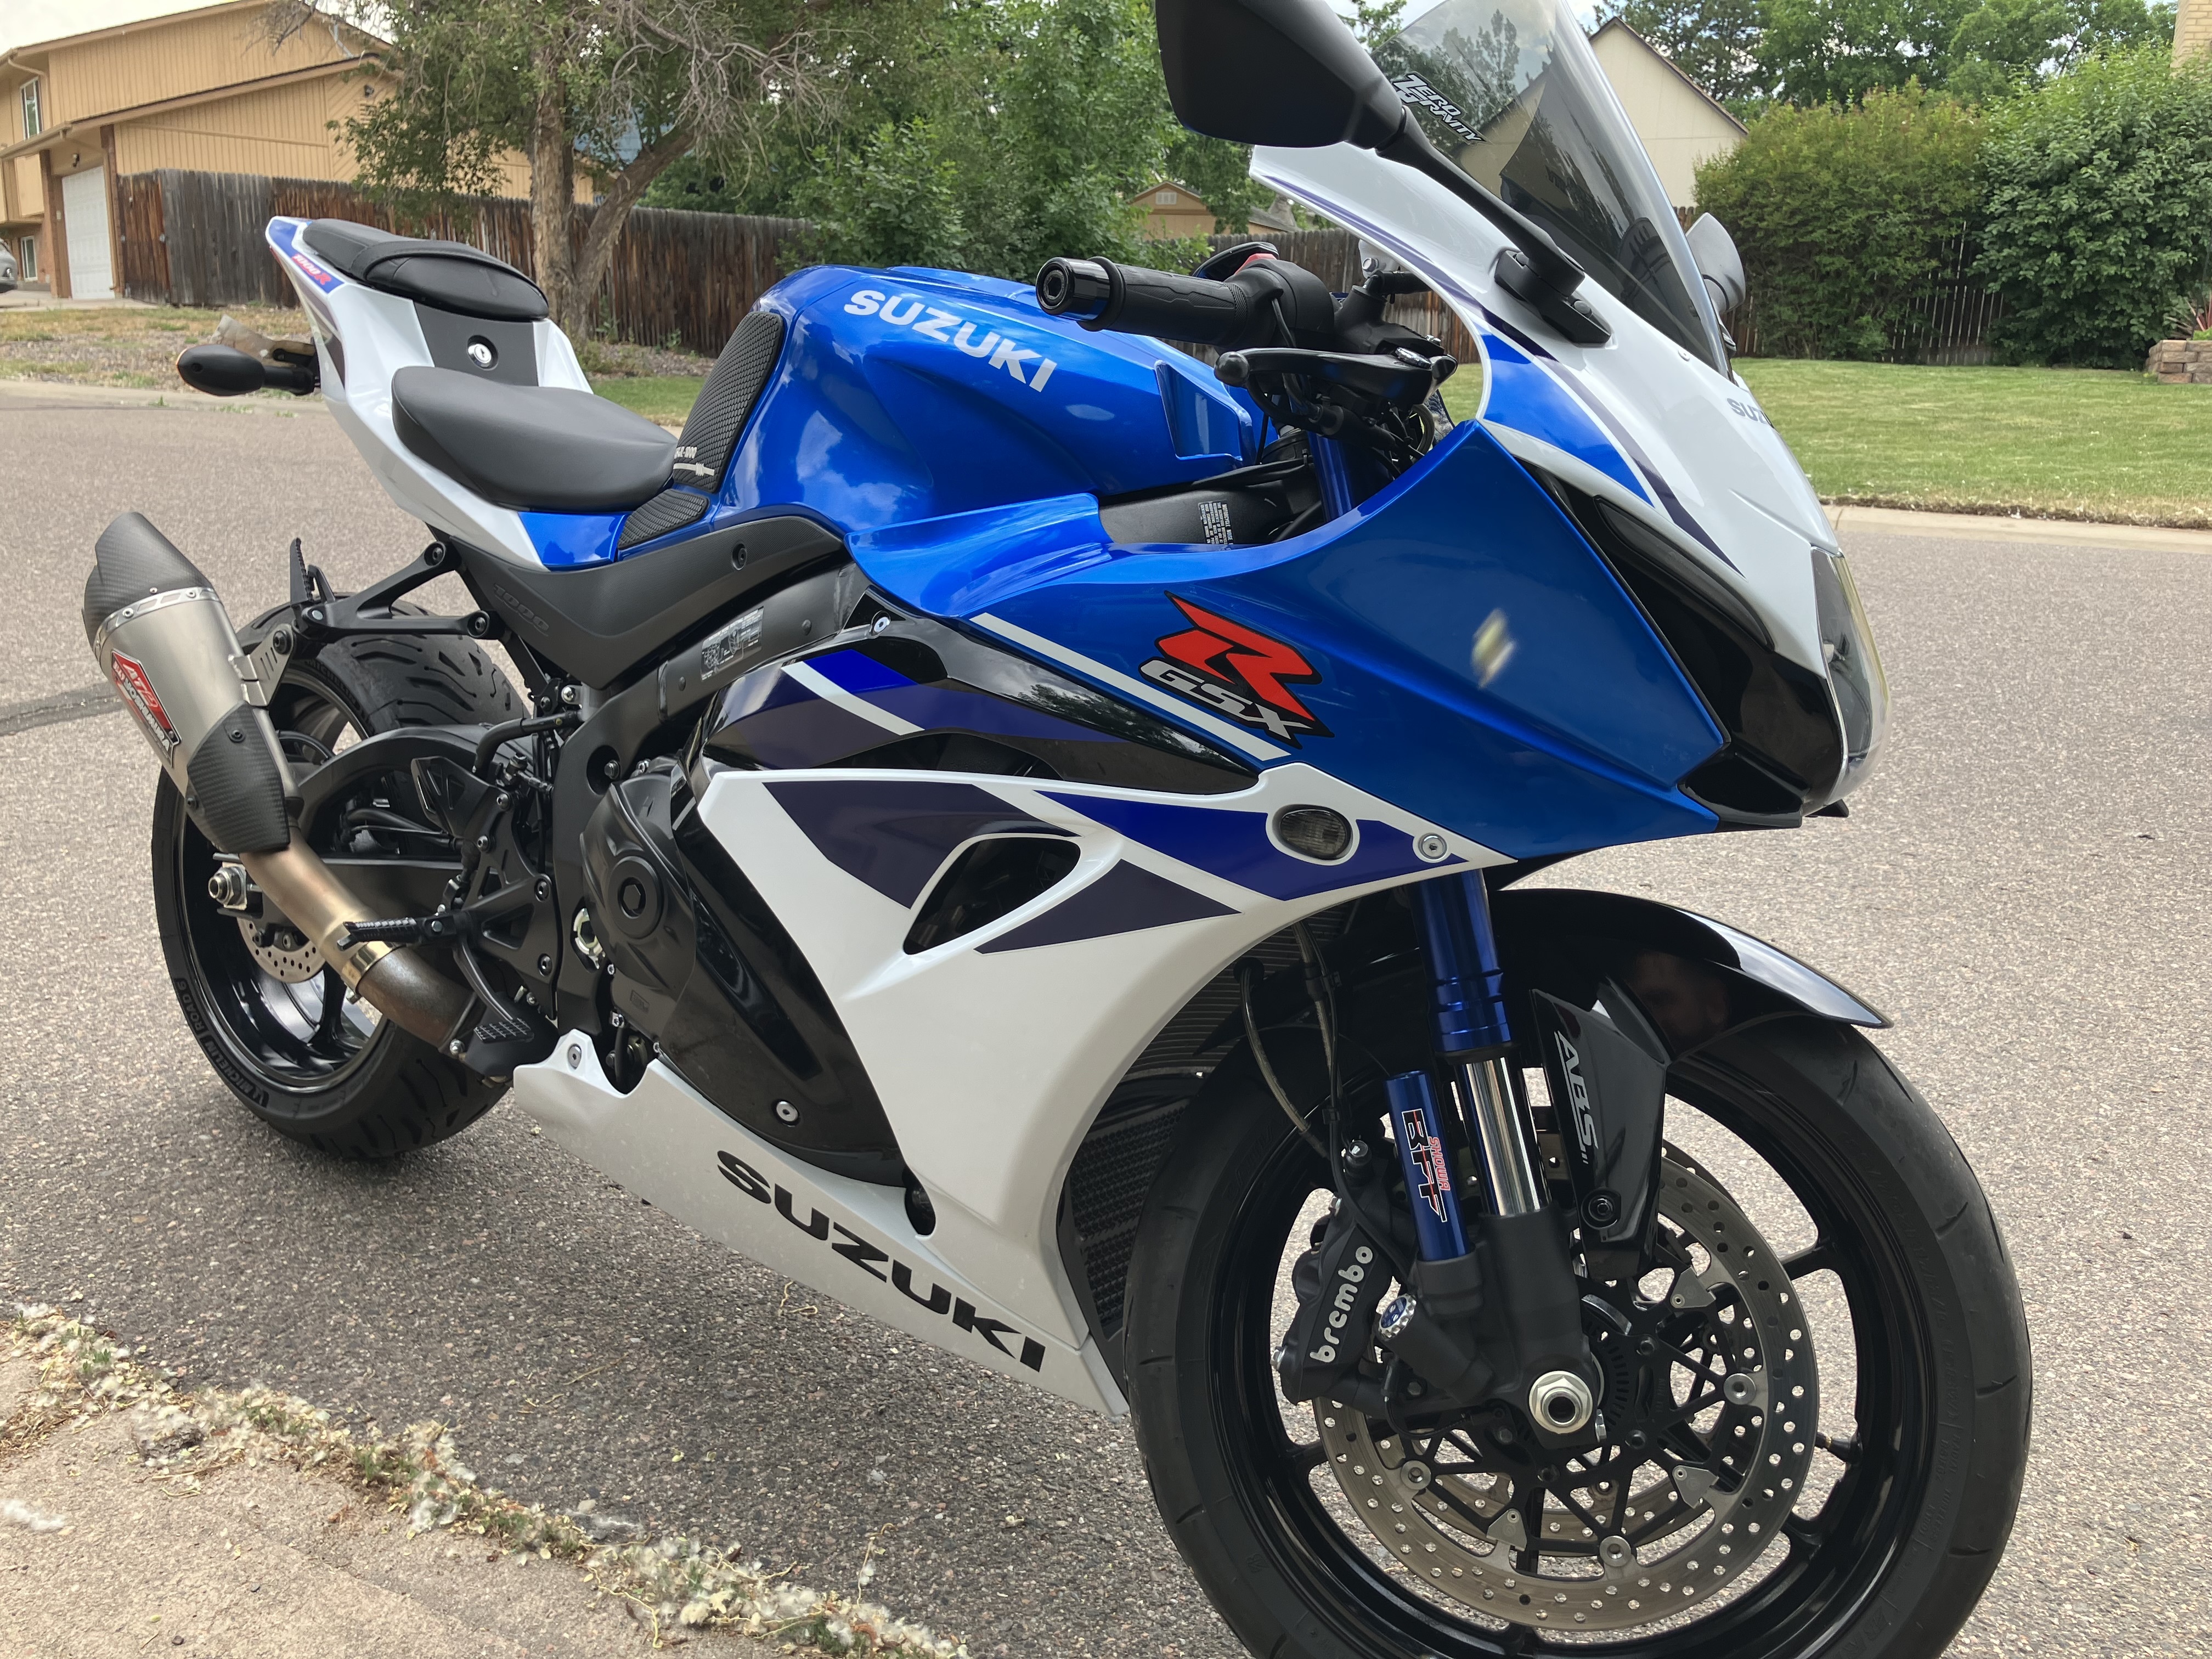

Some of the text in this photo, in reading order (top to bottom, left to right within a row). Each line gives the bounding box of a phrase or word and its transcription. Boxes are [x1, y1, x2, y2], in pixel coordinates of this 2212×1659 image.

[1393, 74, 1462, 116] ZERO
[1397, 89, 1482, 142] GRAVITY
[844, 290, 1057, 392] SUZUKI
[494, 583, 549, 636] 1000
[1158, 597, 1315, 721] R
[123, 677, 170, 752] YOSHIMURA
[1140, 660, 1313, 740] GSX
[183, 994, 205, 1031] ROAD
[205, 1040, 253, 1094] MICHELIN
[1557, 1030, 1598, 1149] ABS
[1428, 1136, 1451, 1191] SHOWA
[717, 1150, 1046, 1373] SUZUKI
[1310, 1246, 1373, 1363] brembo
